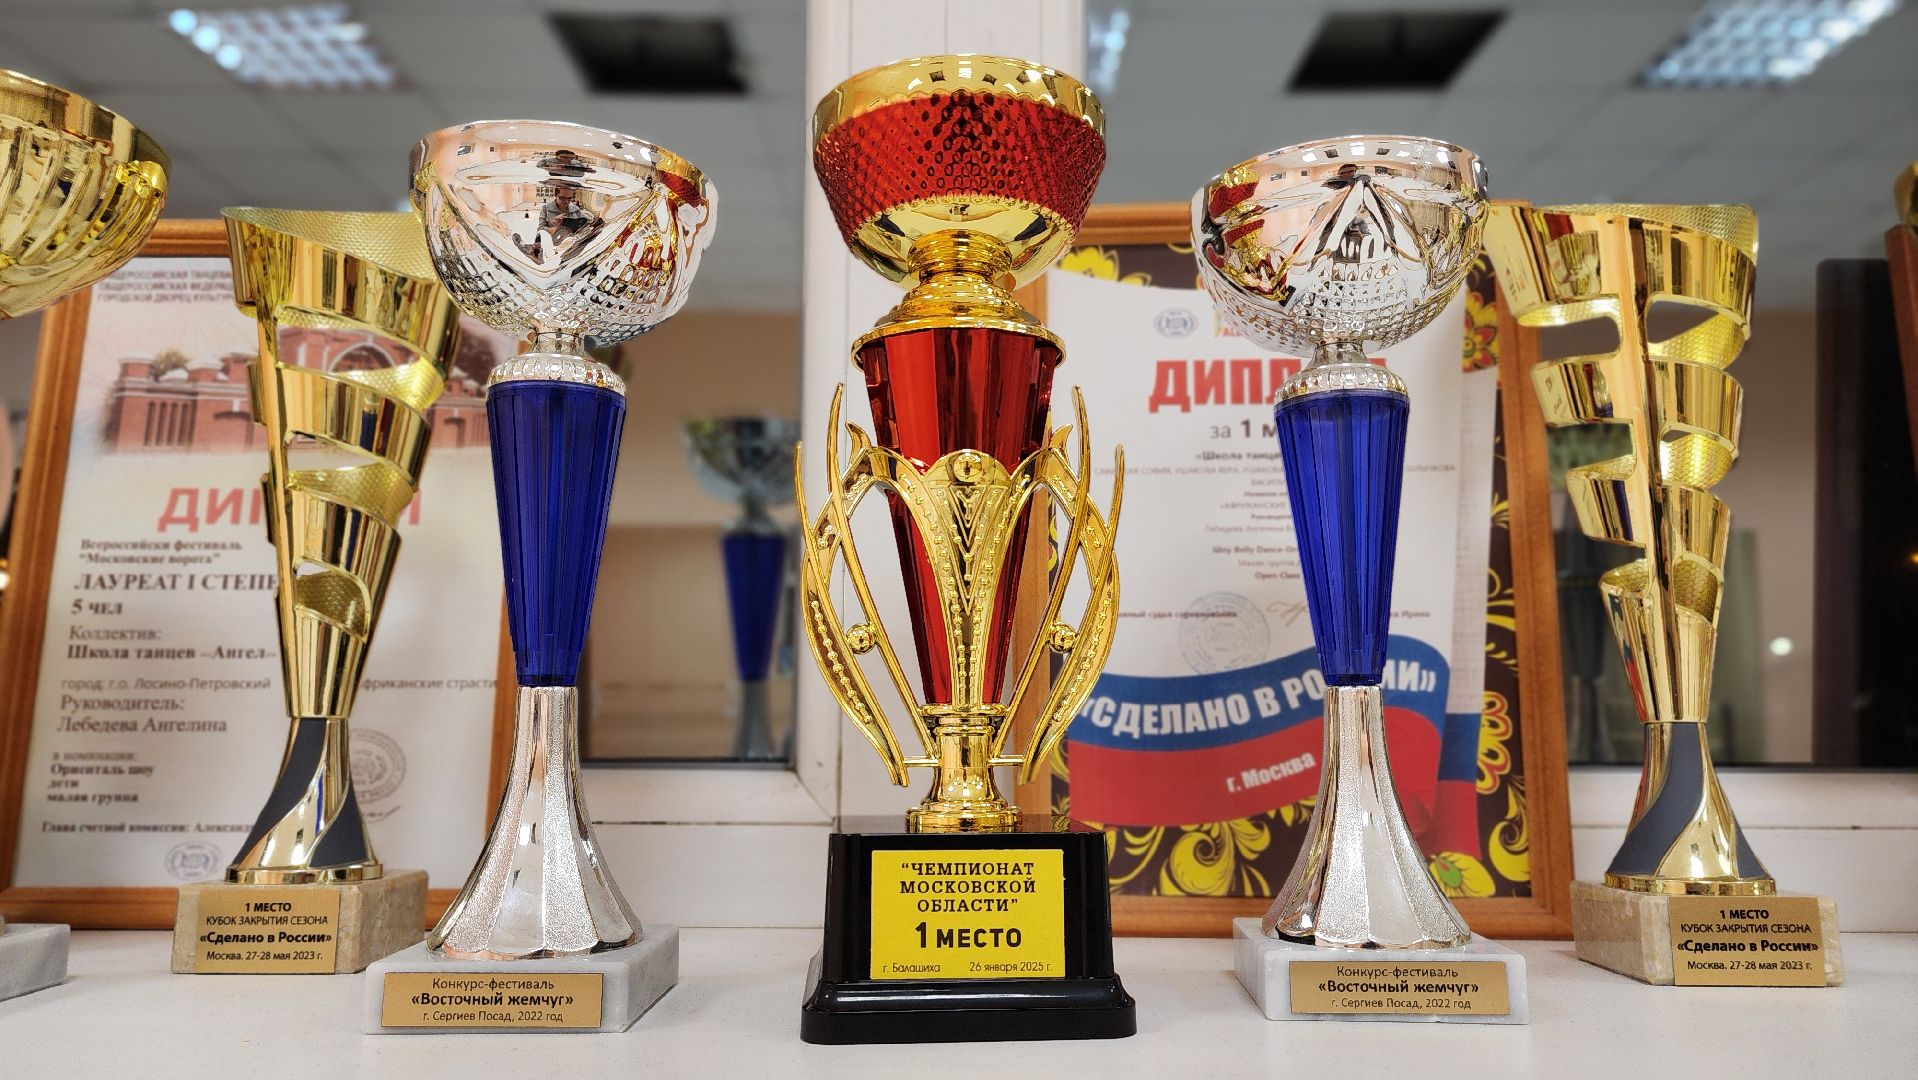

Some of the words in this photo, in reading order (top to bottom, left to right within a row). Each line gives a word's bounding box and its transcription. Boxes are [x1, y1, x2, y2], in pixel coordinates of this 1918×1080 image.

[1148, 358, 1388, 414] ДИПЛ
[1210, 428, 1231, 440] за
[1240, 420, 1251, 438] 1
[173, 539, 243, 552] фестиваль
[74, 573, 182, 591] ЛАУРЕАТ
[71, 598, 83, 615] 5
[68, 625, 162, 641] Коллектив:
[67, 644, 129, 660] Школа
[134, 646, 196, 662] танцев
[133, 677, 271, 692] Лосино-Петровский
[59, 695, 185, 715] Руководитель:
[1079, 691, 1251, 739] «СДЕЛАНО
[1251, 684, 1282, 720] В
[56, 716, 138, 734] Лебедева
[142, 717, 227, 734] Ангелина
[1226, 774, 1242, 794] г.
[1240, 750, 1317, 791] Москва
[91, 793, 139, 805] группа
[901, 862, 1034, 876] “ЧЕМПИОНАТ
[900, 877, 1036, 894] МОСКОВСКОЙ
[245, 902, 251, 912] 1
[254, 902, 292, 912] МЕСТО
[917, 899, 1018, 913] ОБЛАСТИ”
[206, 915, 237, 926] КУБОК
[239, 915, 288, 926] ЗАКРЫТИЯ
[290, 915, 328, 925] СЕЗОНА
[1720, 909, 1726, 919] 1
[1729, 909, 1769, 920] МЕСТО
[915, 921, 927, 948] 1
[936, 927, 1022, 948] МЕСТО
[1680, 923, 1714, 934] КУБОК
[1715, 923, 1769, 934] ЗАКРЫТИЯ
[1770, 923, 1812, 934] СЕЗОНА
[200, 931, 264, 945] «Сделано
[267, 934, 275, 942] в
[278, 931, 332, 943] России»
[1677, 939, 1746, 954] «Сделано
[1749, 942, 1758, 952] в
[1760, 939, 1819, 952] России»
[206, 951, 244, 960] Москва.
[245, 950, 272, 960] 27-28
[272, 952, 291, 960] мая
[292, 950, 315, 960] 2023
[316, 952, 323, 960] г.
[882, 965, 890, 973] г.
[892, 962, 941, 973] Балашиха
[969, 961, 982, 972] 26
[984, 964, 1018, 974] января
[1020, 961, 1044, 972] 2025
[1046, 964, 1053, 972] г.
[1336, 965, 1459, 980] Конкурс-фестиваль
[1687, 960, 1728, 970] Москва.
[1729, 960, 1757, 970] 27-28
[1758, 962, 1778, 970] мая
[1780, 960, 1803, 970] 2023
[1805, 962, 1813, 970] г.
[432, 977, 555, 992] Конкурс-фестиваль
[1318, 979, 1409, 994] «Восточный
[1413, 982, 1479, 996] жемчуг»
[411, 991, 503, 1006] «Восточный
[508, 994, 574, 1008] жемчуг»
[1331, 1000, 1338, 1008] г.
[1341, 997, 1384, 1010] Сергиев
[1386, 998, 1422, 1010] Посад,
[1425, 998, 1450, 1009] 2022
[1453, 1000, 1472, 1010] год
[422, 1012, 430, 1021] г.
[432, 1010, 476, 1023] Сергиев
[478, 1010, 515, 1023] Посад,
[517, 1010, 543, 1021] 2022
[546, 1012, 564, 1023] год
